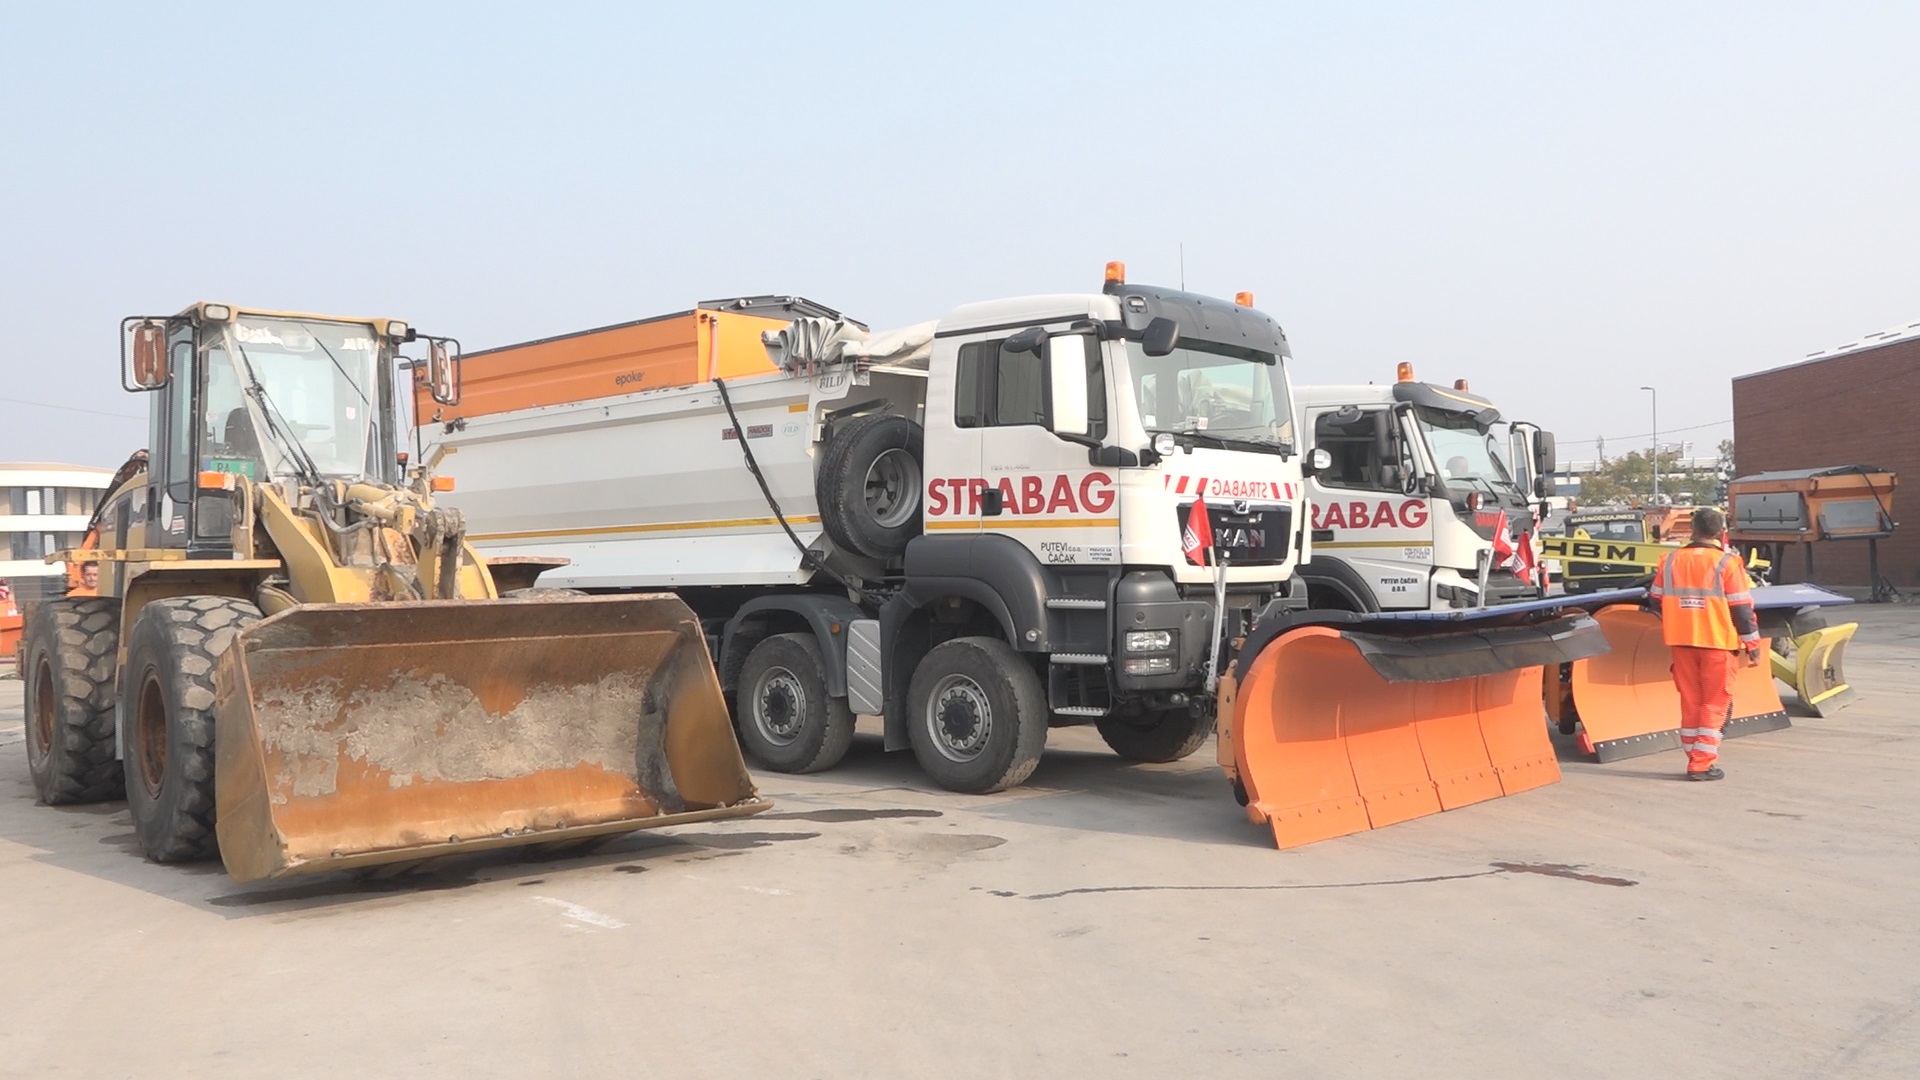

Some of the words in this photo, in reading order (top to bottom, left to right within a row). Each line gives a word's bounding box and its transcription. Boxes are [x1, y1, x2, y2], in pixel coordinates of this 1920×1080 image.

[615, 371, 643, 387] epoke
[928, 472, 1116, 516] STRABAG
[1215, 528, 1266, 547] MAN
[1040, 542, 1067, 552] PUTEVI
[1541, 540, 1636, 561] HBM
[1048, 552, 1076, 563] ČAČAK
